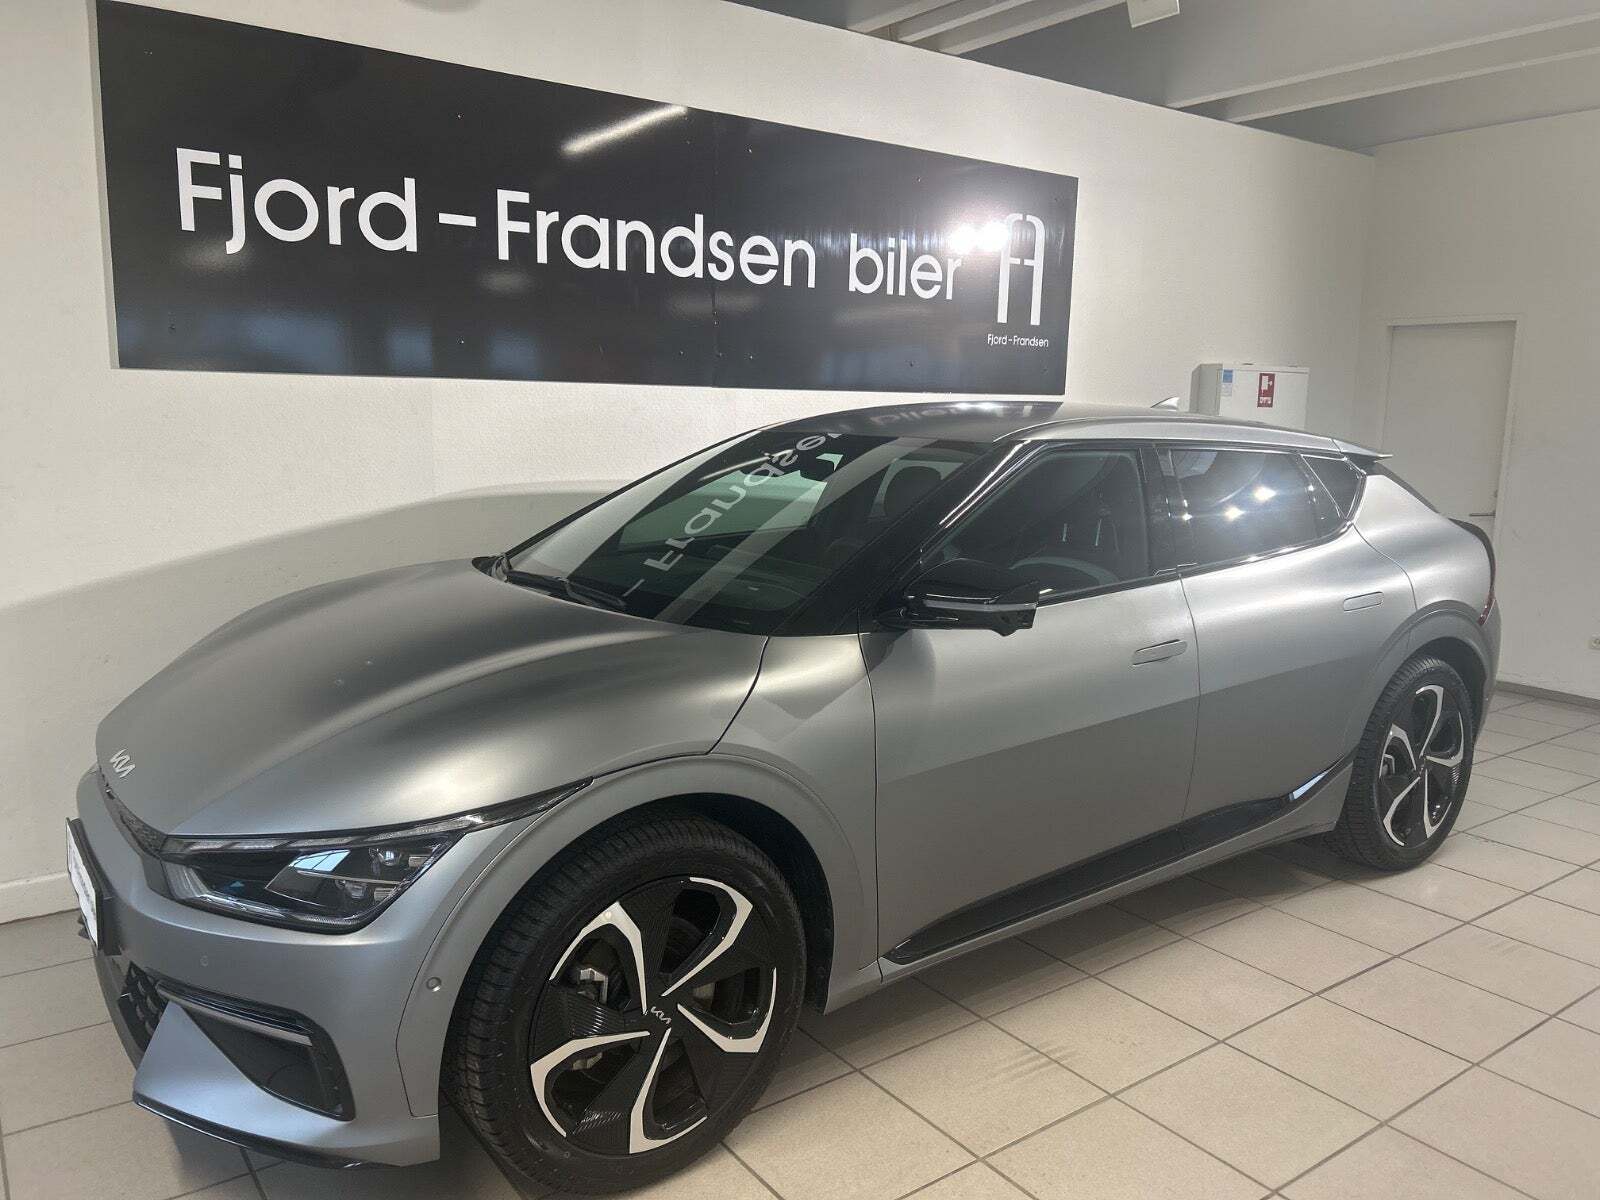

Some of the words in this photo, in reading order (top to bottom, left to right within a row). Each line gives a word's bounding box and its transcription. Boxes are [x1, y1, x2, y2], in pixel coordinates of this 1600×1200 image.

[176, 147, 418, 255] Fjord
[496, 188, 816, 289] Frandsen
[848, 233, 963, 300] biler
[987, 333, 1008, 347] Fjord
[1012, 335, 1049, 348] Frandsen
